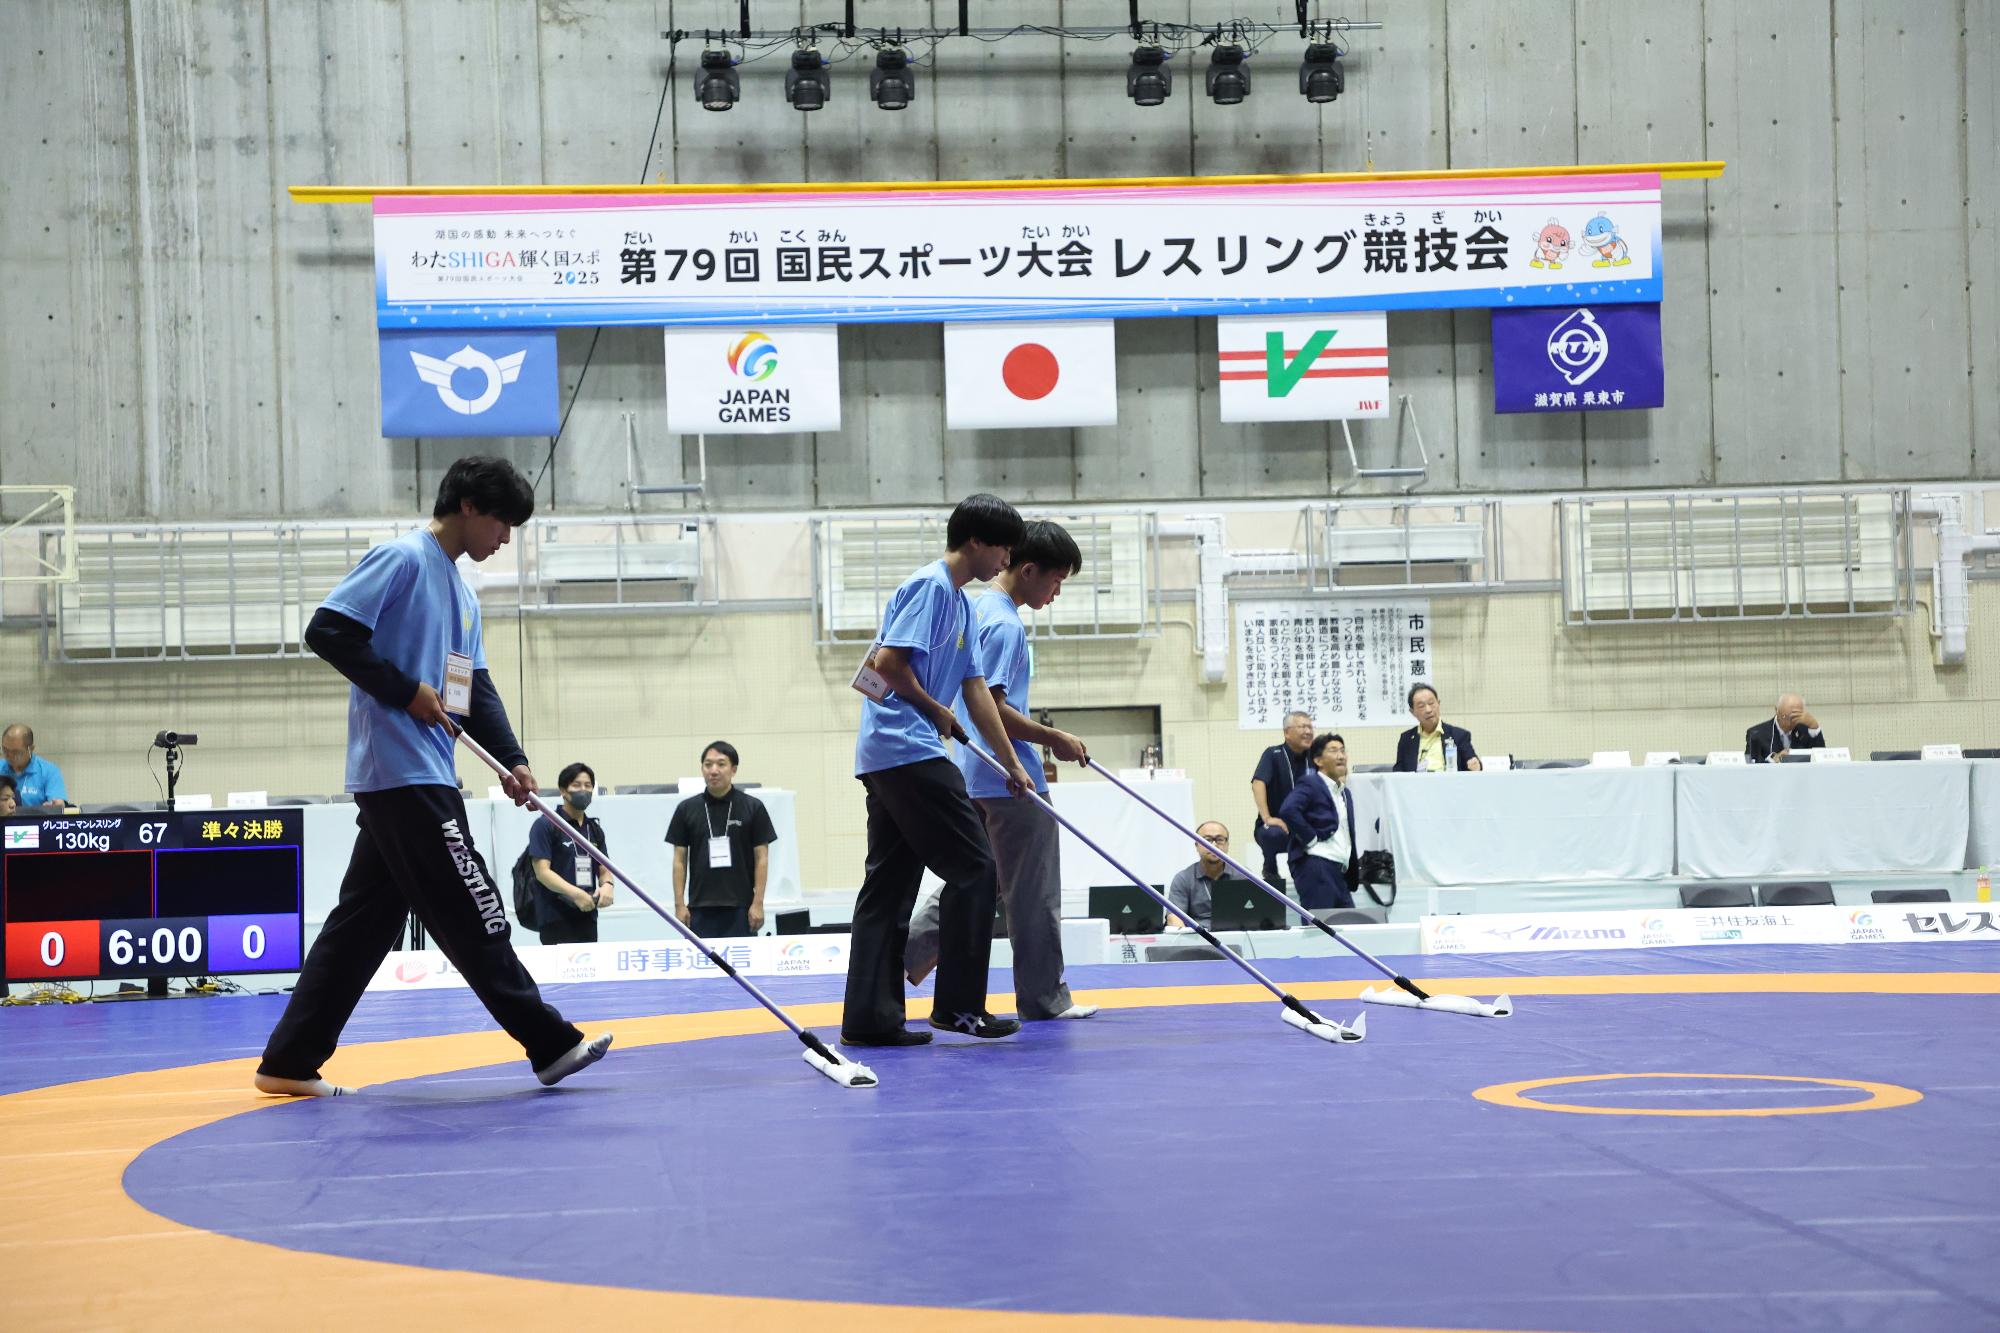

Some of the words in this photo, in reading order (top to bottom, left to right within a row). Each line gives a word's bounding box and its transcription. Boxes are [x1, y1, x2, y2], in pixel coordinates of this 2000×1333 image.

[624, 231, 653, 246] だい
[729, 230, 758, 244] かい
[780, 230, 806, 243] こく
[817, 229, 847, 243] みん
[1022, 225, 1050, 240] たい
[1062, 225, 1090, 238] かい
[1364, 212, 1406, 227] きょう
[1432, 211, 1446, 226] ぎ
[1473, 210, 1502, 223] かい
[619, 247, 760, 285] 第79回
[776, 240, 1094, 283] 国民スポーツ大会
[1115, 225, 1510, 278] レスリング競技会
[718, 388, 790, 405] JAPAN
[1534, 391, 1577, 408] 滋賀県
[1583, 389, 1625, 406] 栗東市
[718, 406, 791, 423] GAMES
[42, 818, 122, 830] グレコローマンレスリング
[138, 822, 168, 844] 67
[202, 820, 284, 842] 準々決勝
[55, 832, 110, 852] 130kg
[40, 931, 65, 967] 0
[108, 926, 202, 966] 6:00
[242, 925, 266, 960] 0
[617, 945, 752, 973] 時事通信
